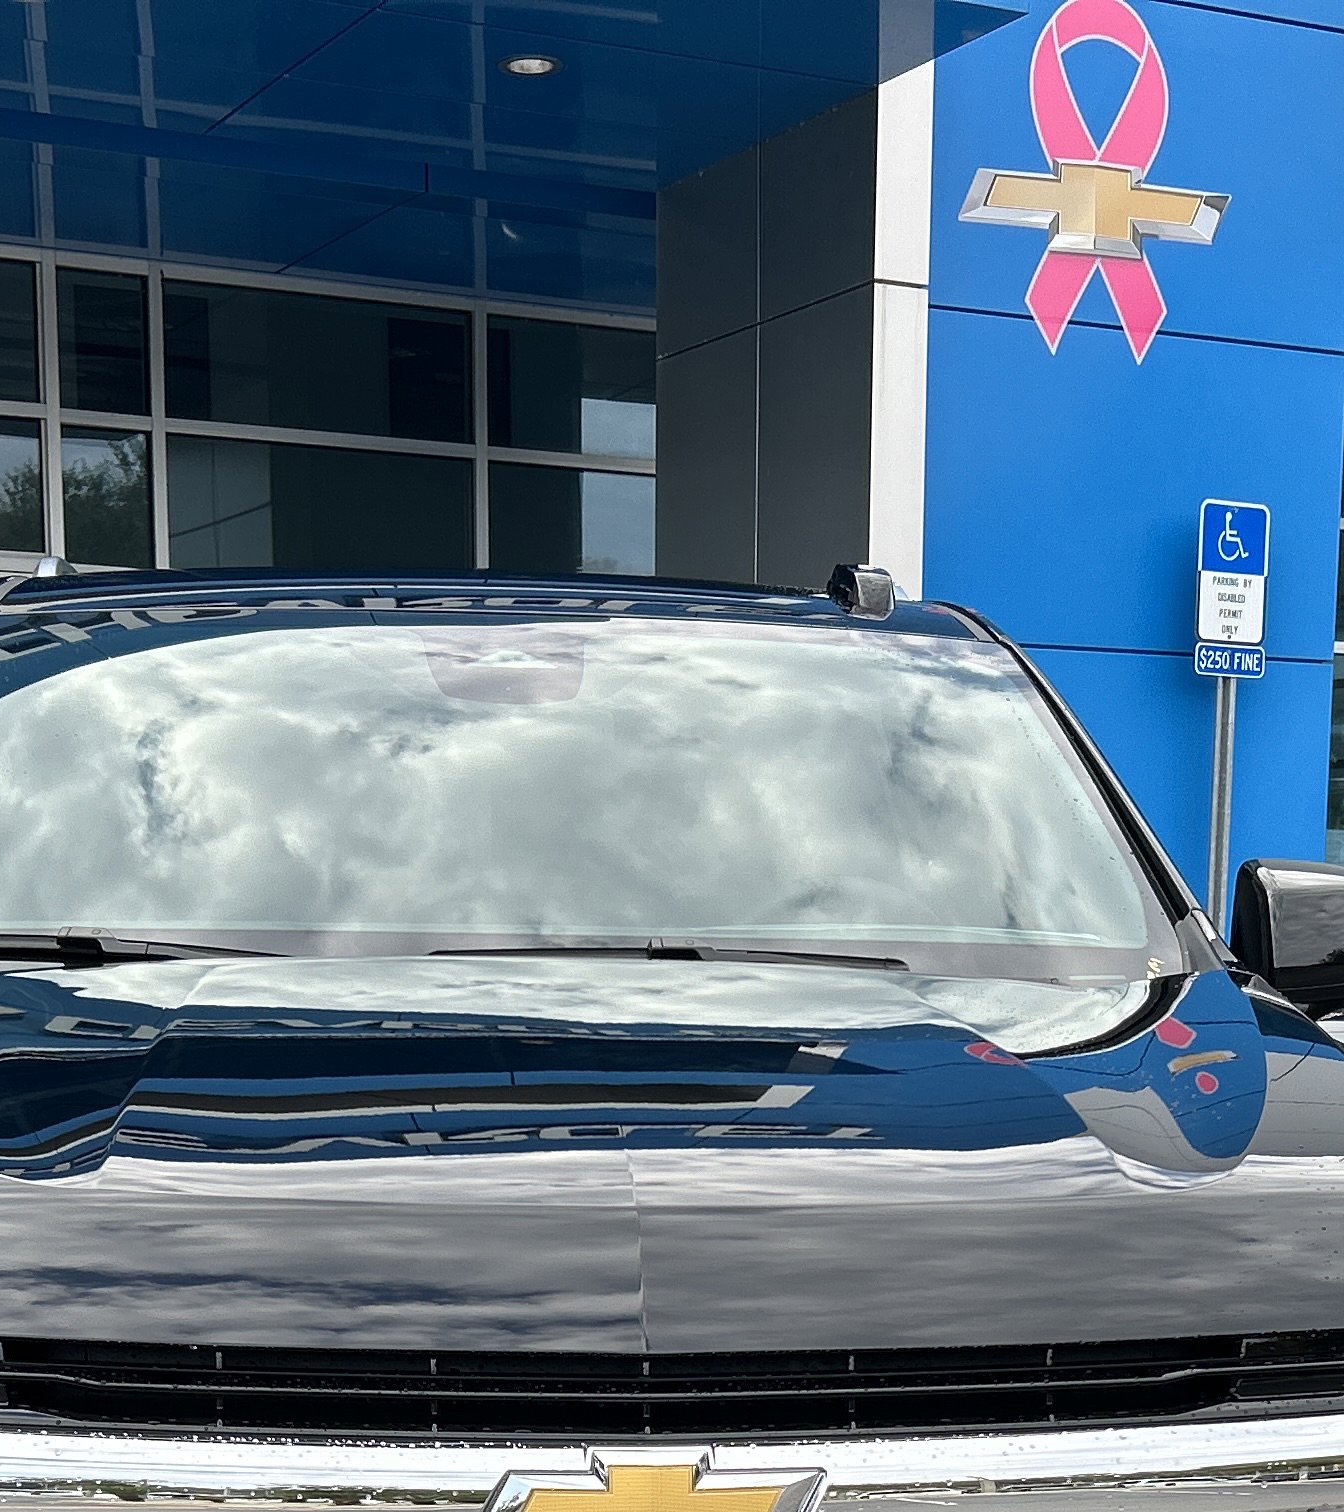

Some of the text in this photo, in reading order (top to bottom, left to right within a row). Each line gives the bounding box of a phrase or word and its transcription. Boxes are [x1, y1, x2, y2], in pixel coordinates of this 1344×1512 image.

[1212, 576, 1252, 588] PARKING BY
[1218, 593, 1245, 603] DISABLED
[1219, 609, 1243, 619] PERMIT
[1221, 625, 1238, 634] ONLY
[1199, 647, 1261, 672] $250 FINE
